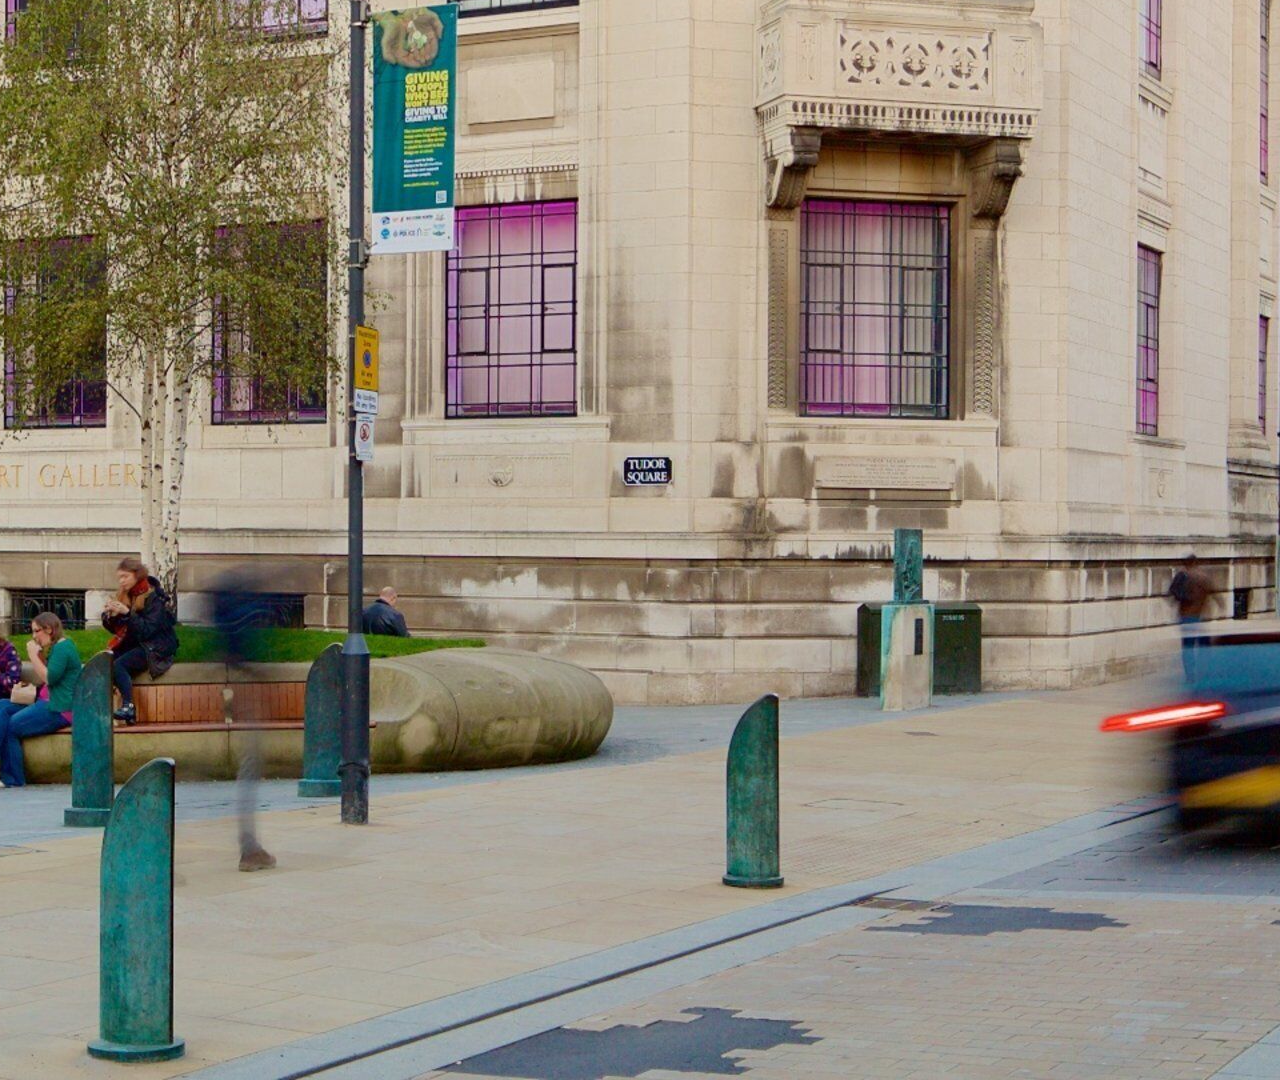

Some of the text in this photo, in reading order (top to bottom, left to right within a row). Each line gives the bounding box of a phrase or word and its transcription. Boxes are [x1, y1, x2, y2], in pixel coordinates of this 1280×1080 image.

[405, 70, 449, 85] GIVING
[405, 81, 449, 93] TO PEOPLE
[405, 89, 449, 101] WHO BEG
[405, 105, 448, 117] GIVING TO
[405, 115, 431, 123] CHARITY
[628, 459, 666, 469] TUDOR
[37, 464, 139, 488] GALLER
[627, 471, 668, 483] SQUARE
